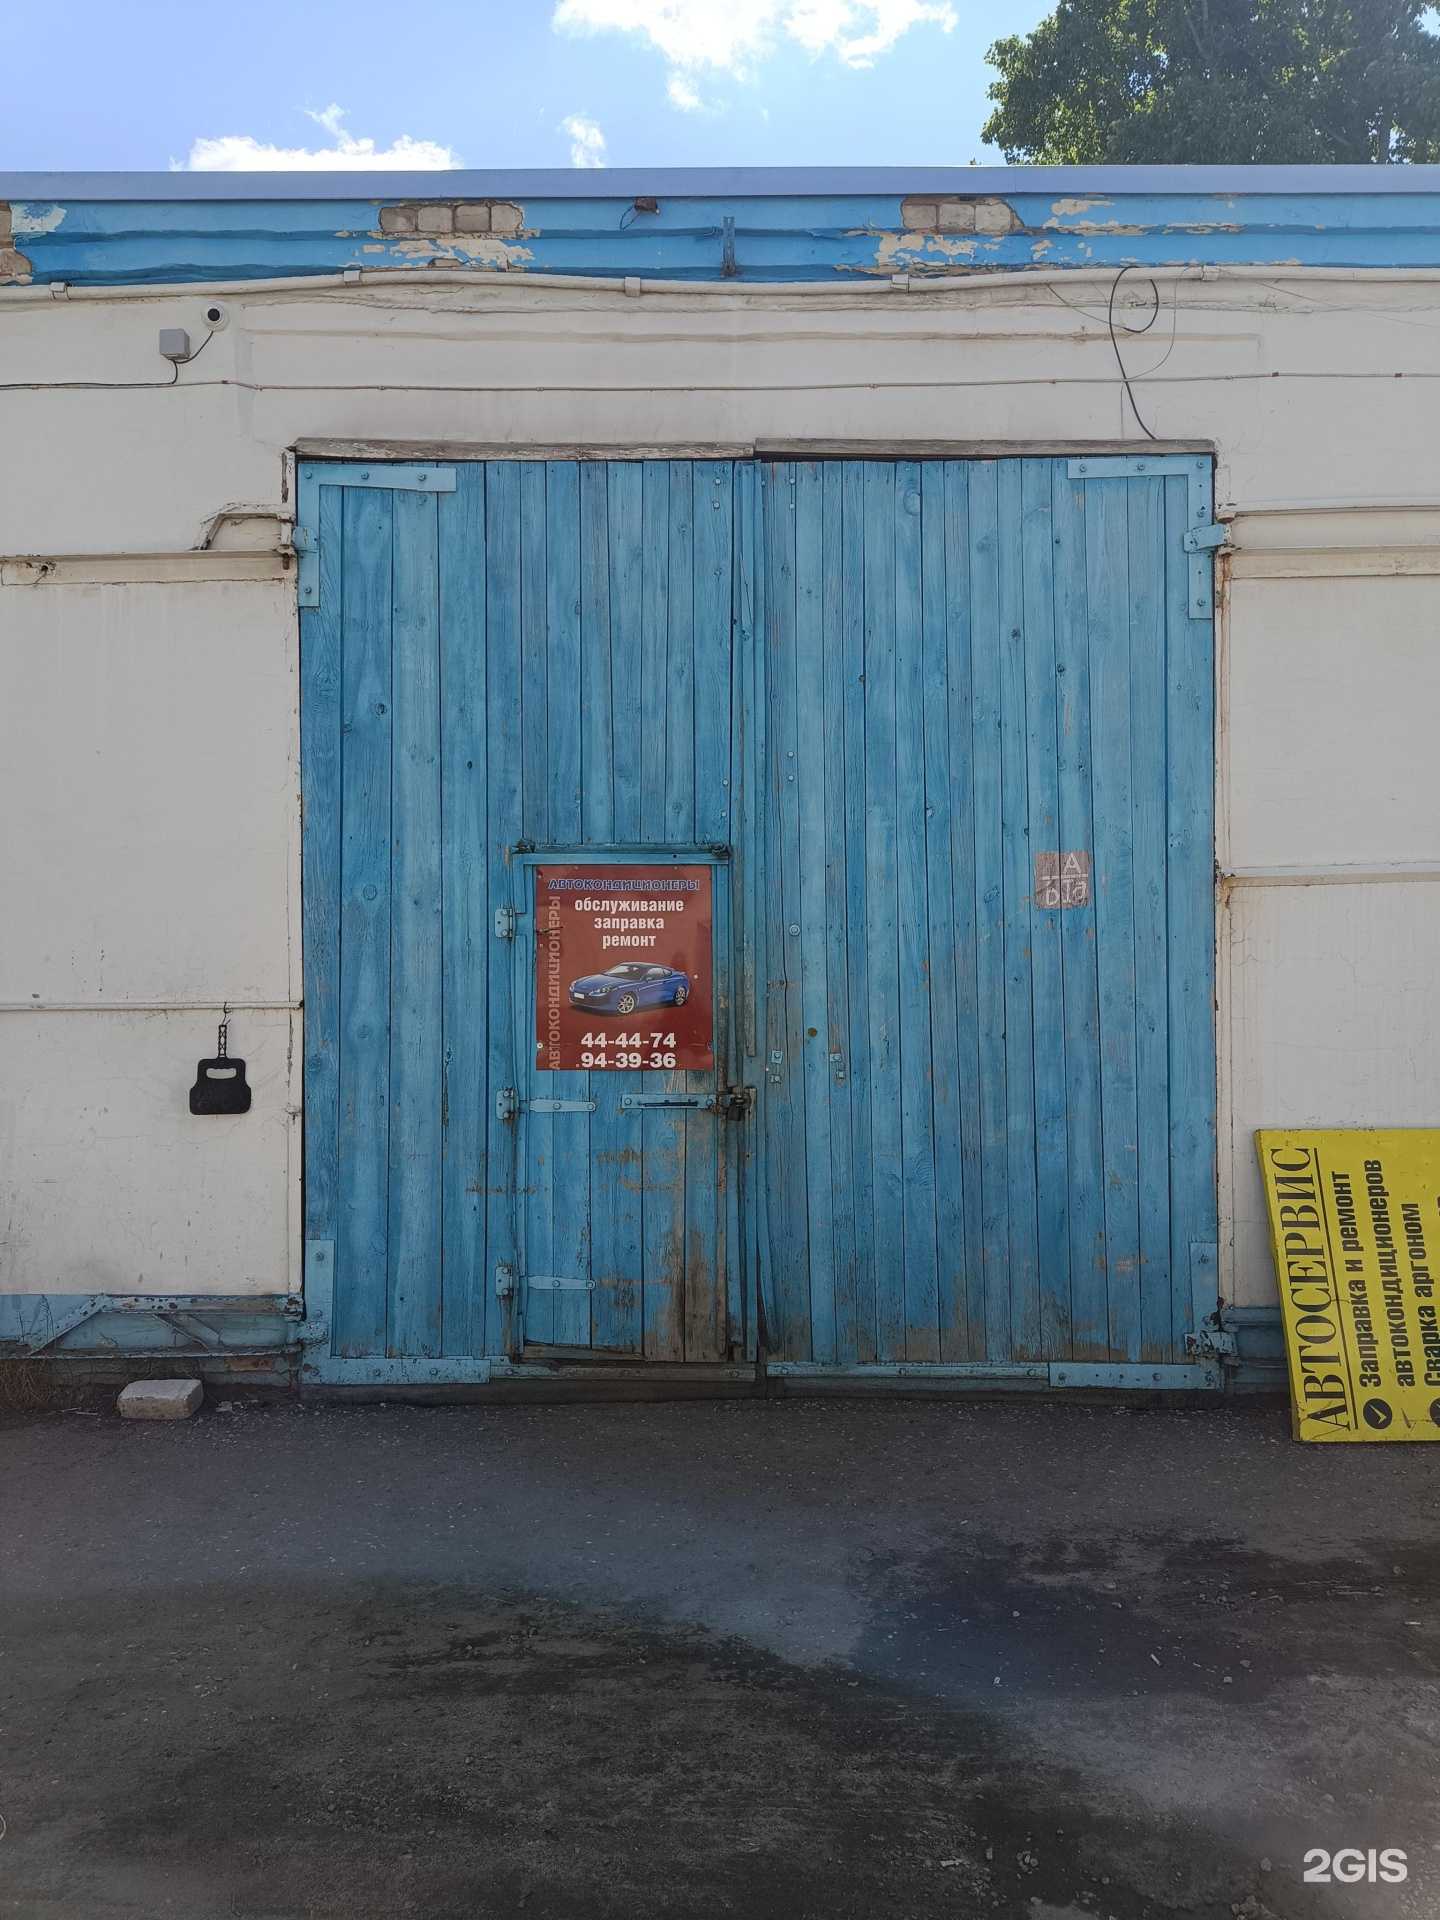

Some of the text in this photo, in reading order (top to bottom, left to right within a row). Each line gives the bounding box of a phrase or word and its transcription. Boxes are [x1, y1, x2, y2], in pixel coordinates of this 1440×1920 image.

[548, 879, 699, 891] АВТОКОНДИЦИОНЕРЫ
[574, 897, 684, 914] обслуживание
[594, 916, 665, 932] заправка
[602, 935, 657, 949] ремонт
[548, 895, 561, 1070] АВТОКОНДИЦИОНЕРЫ
[580, 1032, 677, 1048] 44-44-74
[580, 1052, 677, 1068] 94-39-36
[1331, 1171, 1382, 1388] Заправка и ремонт
[1364, 1159, 1416, 1387] автокондиционеров
[1270, 1147, 1351, 1432] АВТОСЕРВИС
[1401, 1203, 1440, 1387] Сварка аргоном
